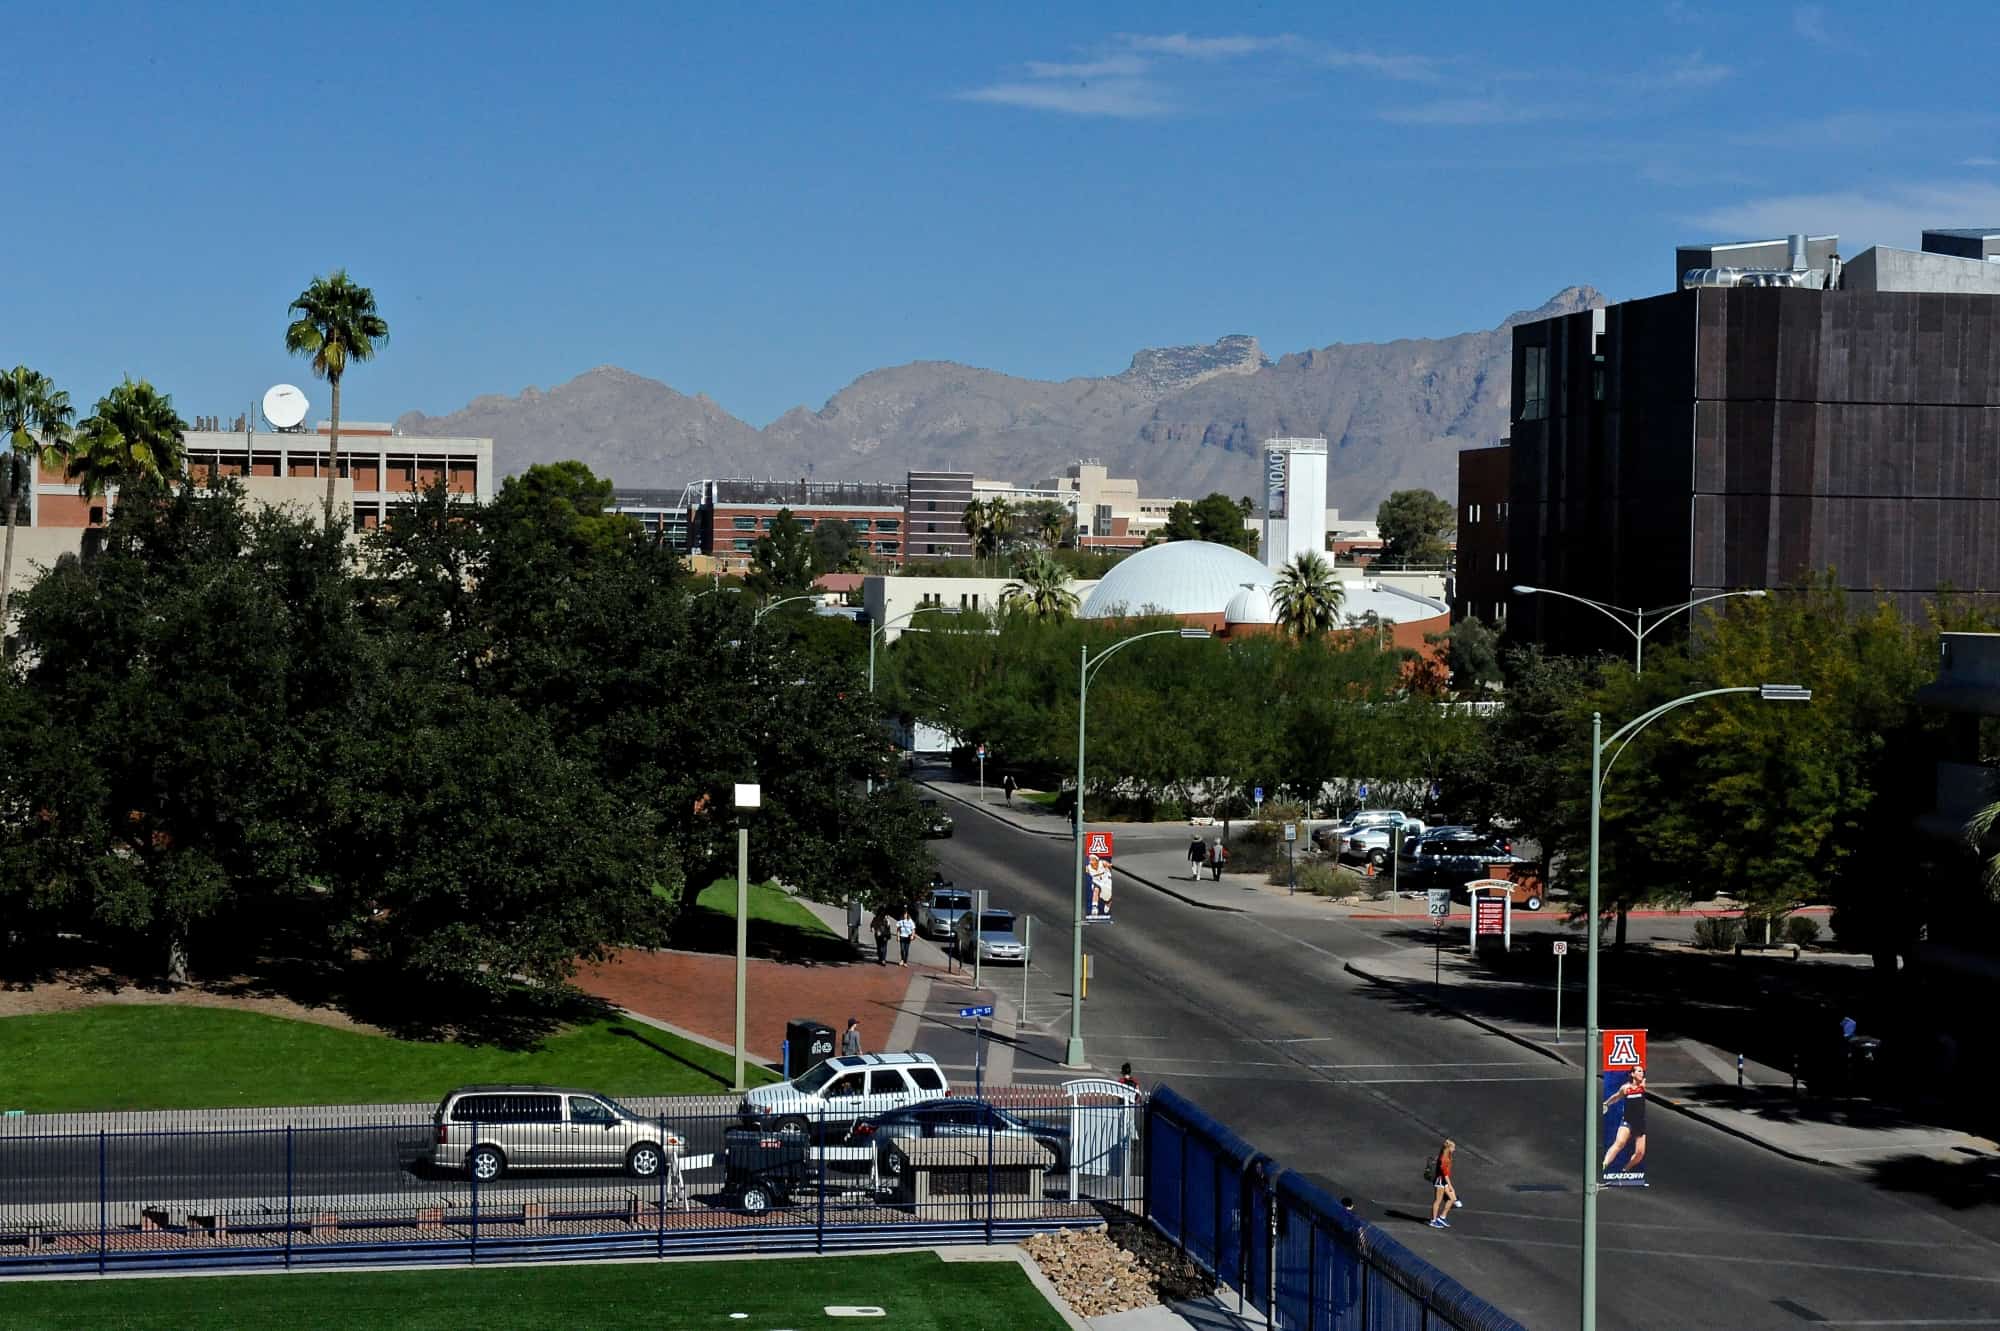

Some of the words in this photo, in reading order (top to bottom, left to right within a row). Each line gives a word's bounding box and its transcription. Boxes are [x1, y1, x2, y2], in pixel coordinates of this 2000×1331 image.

[1089, 835, 1109, 854] A
[1431, 904, 1447, 914] 20
[1609, 1035, 1640, 1065] A
